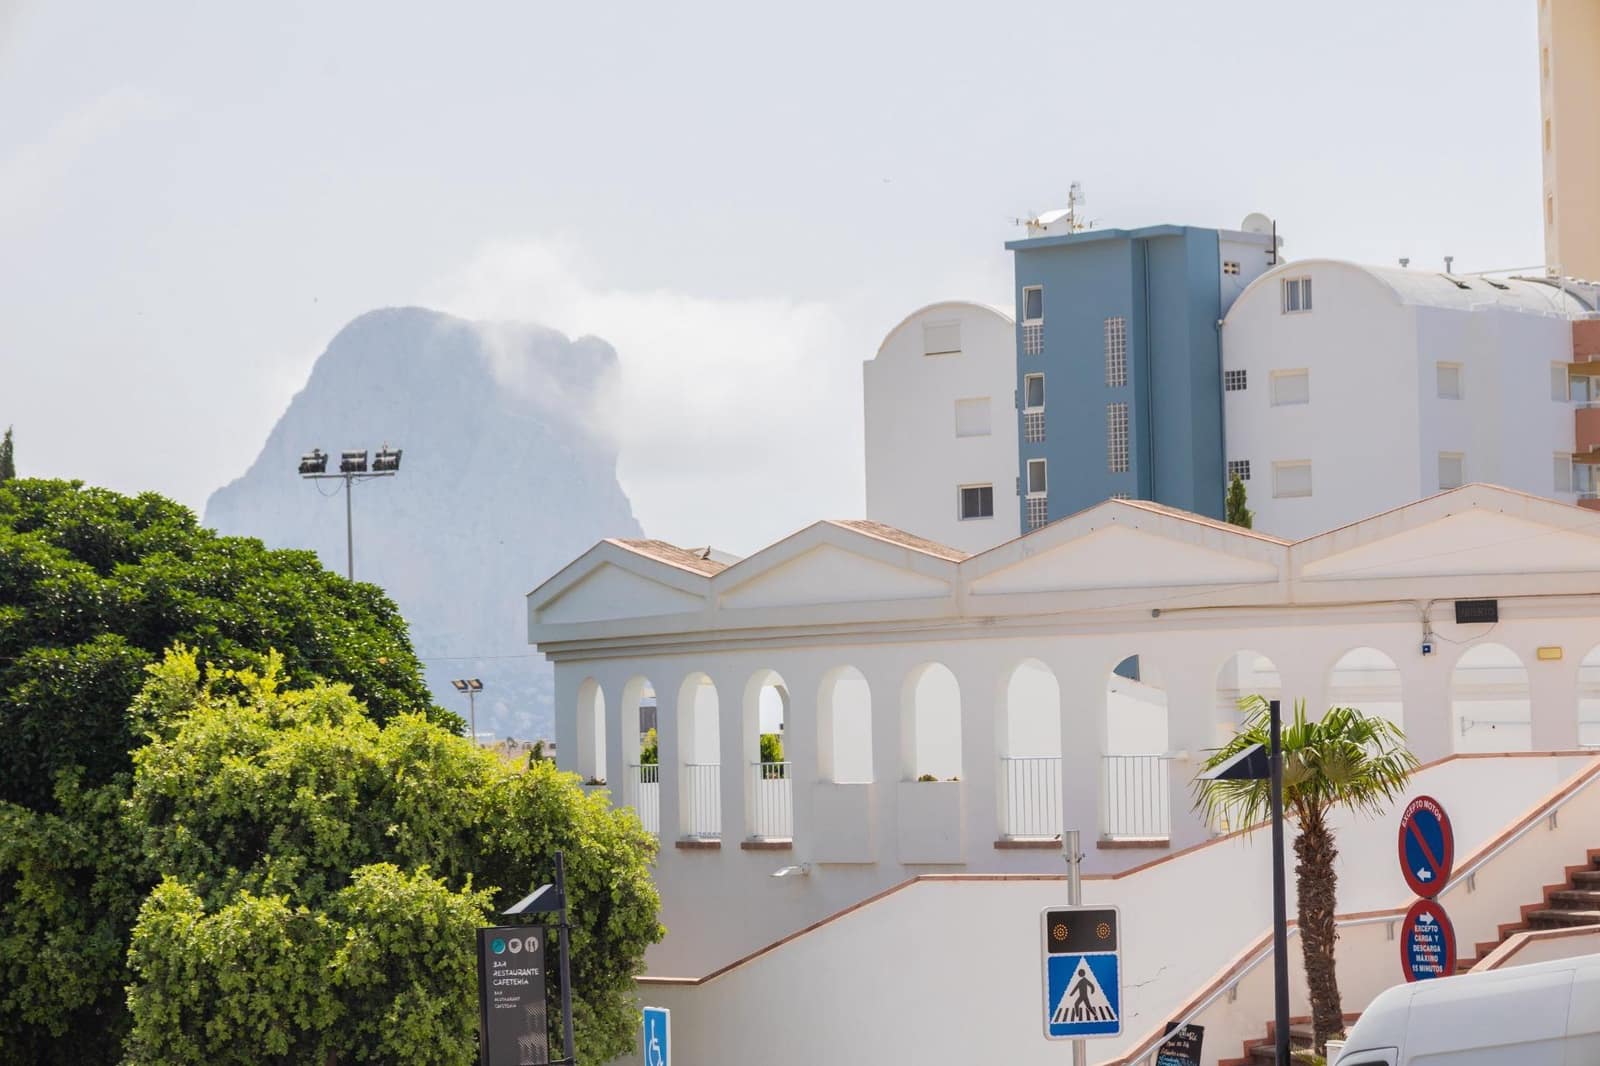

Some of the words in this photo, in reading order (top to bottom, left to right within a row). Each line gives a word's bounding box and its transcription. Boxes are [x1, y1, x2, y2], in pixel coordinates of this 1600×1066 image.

[1402, 800, 1423, 828] EXCEPTO
[1424, 800, 1442, 821] MOTOS
[1415, 954, 1438, 962] MÁXIMO
[493, 968, 539, 976] RESTAURANTE
[1412, 964, 1418, 972] 15
[1419, 965, 1443, 973] MINUTOS
